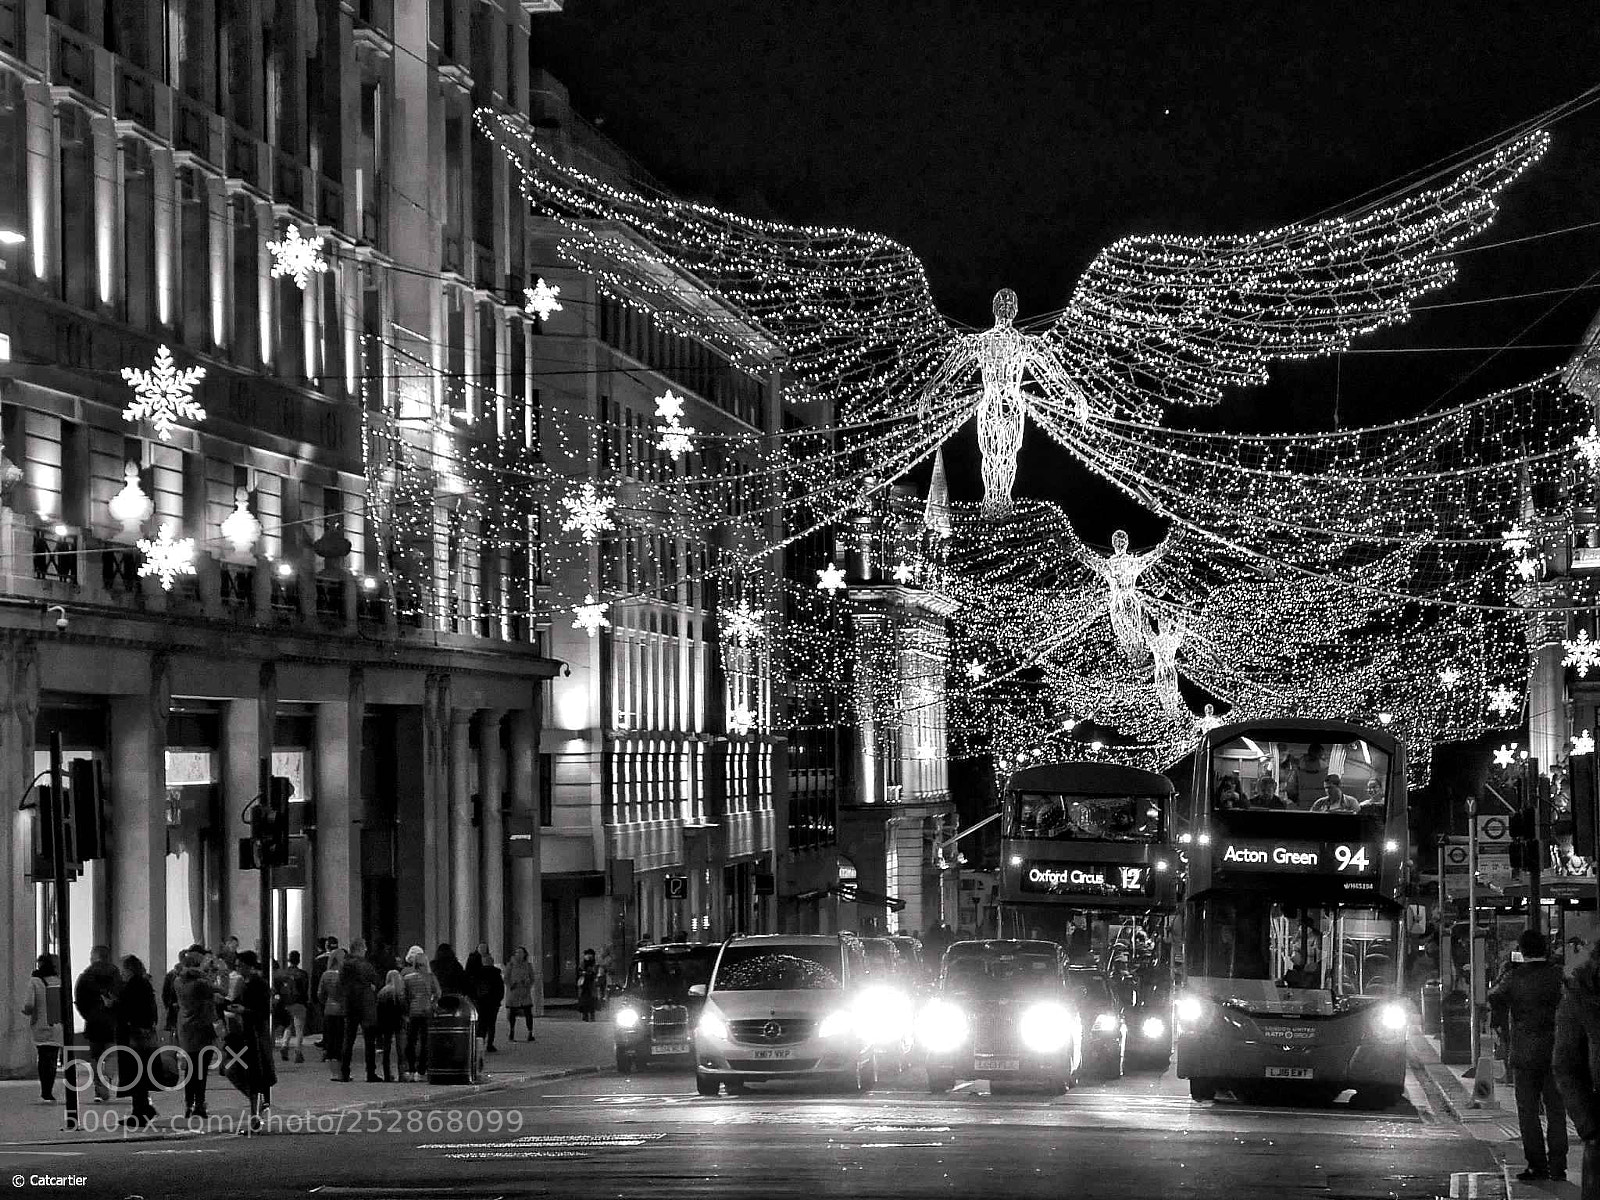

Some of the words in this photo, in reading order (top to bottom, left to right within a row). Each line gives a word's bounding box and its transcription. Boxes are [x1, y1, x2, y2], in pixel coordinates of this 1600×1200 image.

[1466, 799, 1475, 812] Y
[1223, 845, 1268, 863] Acton
[1273, 847, 1318, 865] Green
[1334, 845, 1370, 872] 94
[1029, 868, 1068, 883] Oxford
[1070, 869, 1104, 884] Circus
